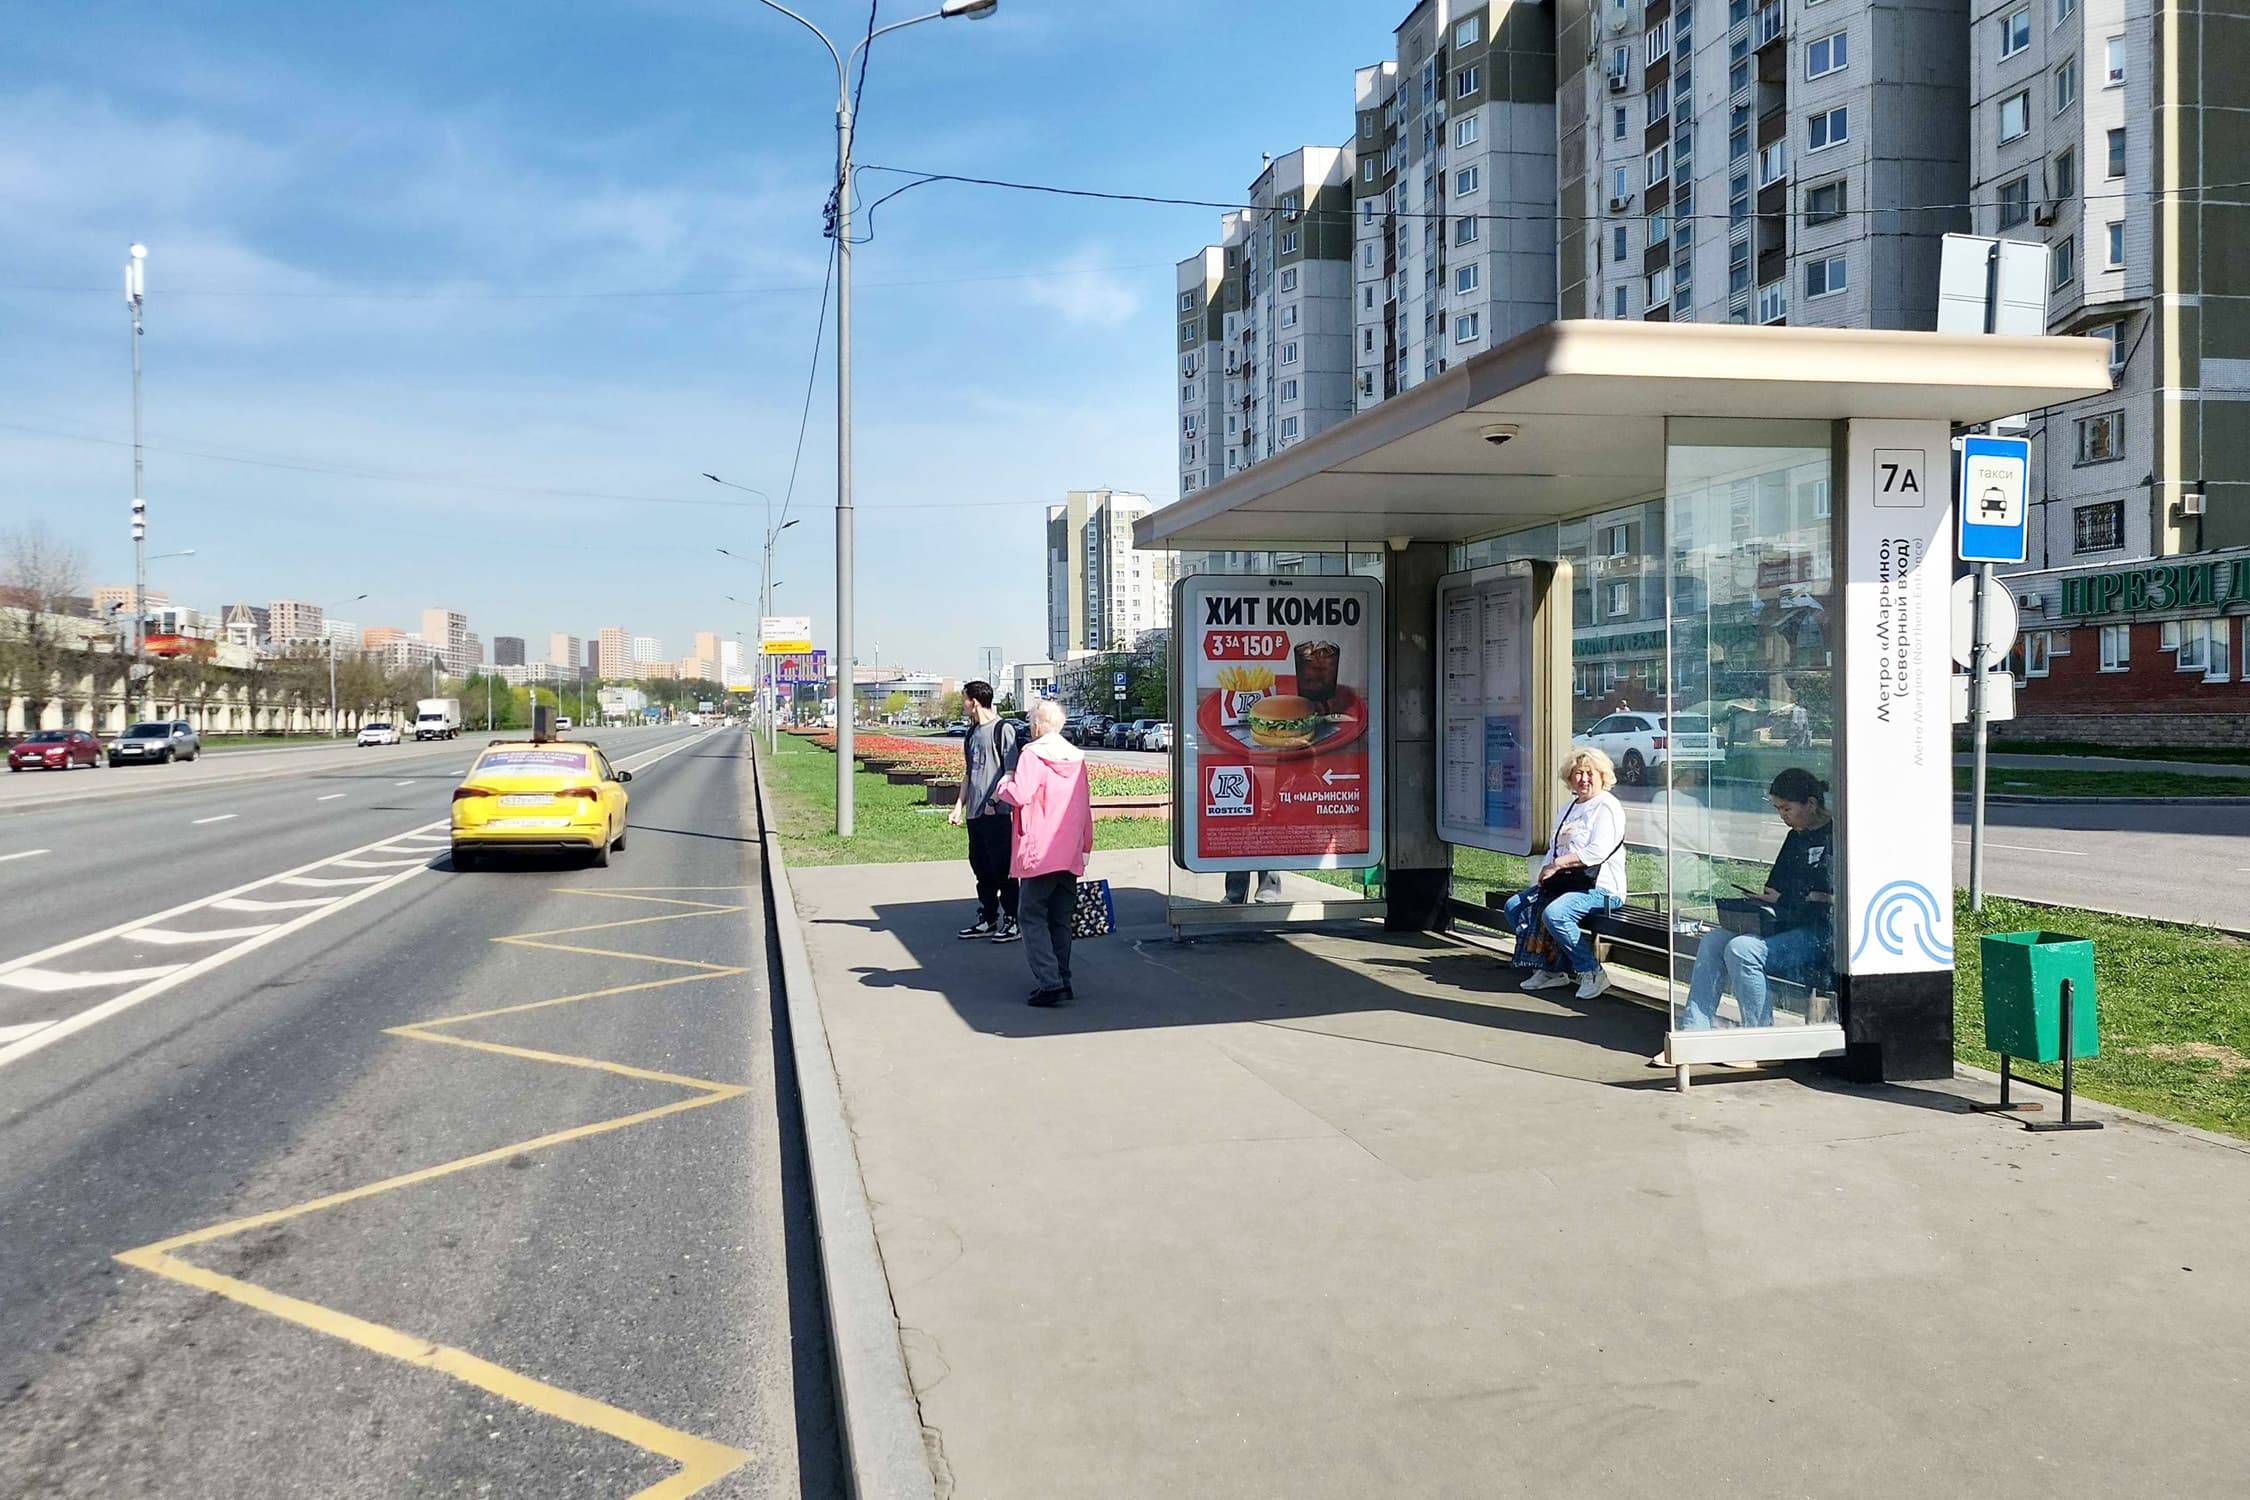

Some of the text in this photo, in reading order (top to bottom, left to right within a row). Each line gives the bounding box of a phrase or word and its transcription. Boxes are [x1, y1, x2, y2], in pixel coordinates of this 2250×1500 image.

[1880, 463, 1919, 493] 7А
[1978, 468, 2014, 480] такси
[1205, 596, 1361, 626] ХИТ КОМБО
[1893, 538, 1911, 697] (северный вход)
[1876, 538, 1893, 723] Метро «Марьино»
[1212, 635, 1224, 657] 3
[1912, 726, 1924, 766] Metro
[1279, 788, 1360, 804] ТЦ «МАРЬИНСКИЙ
[1316, 803, 1360, 815] ПАССАЖ»
[1207, 805, 1252, 814] ROSTIC'S
